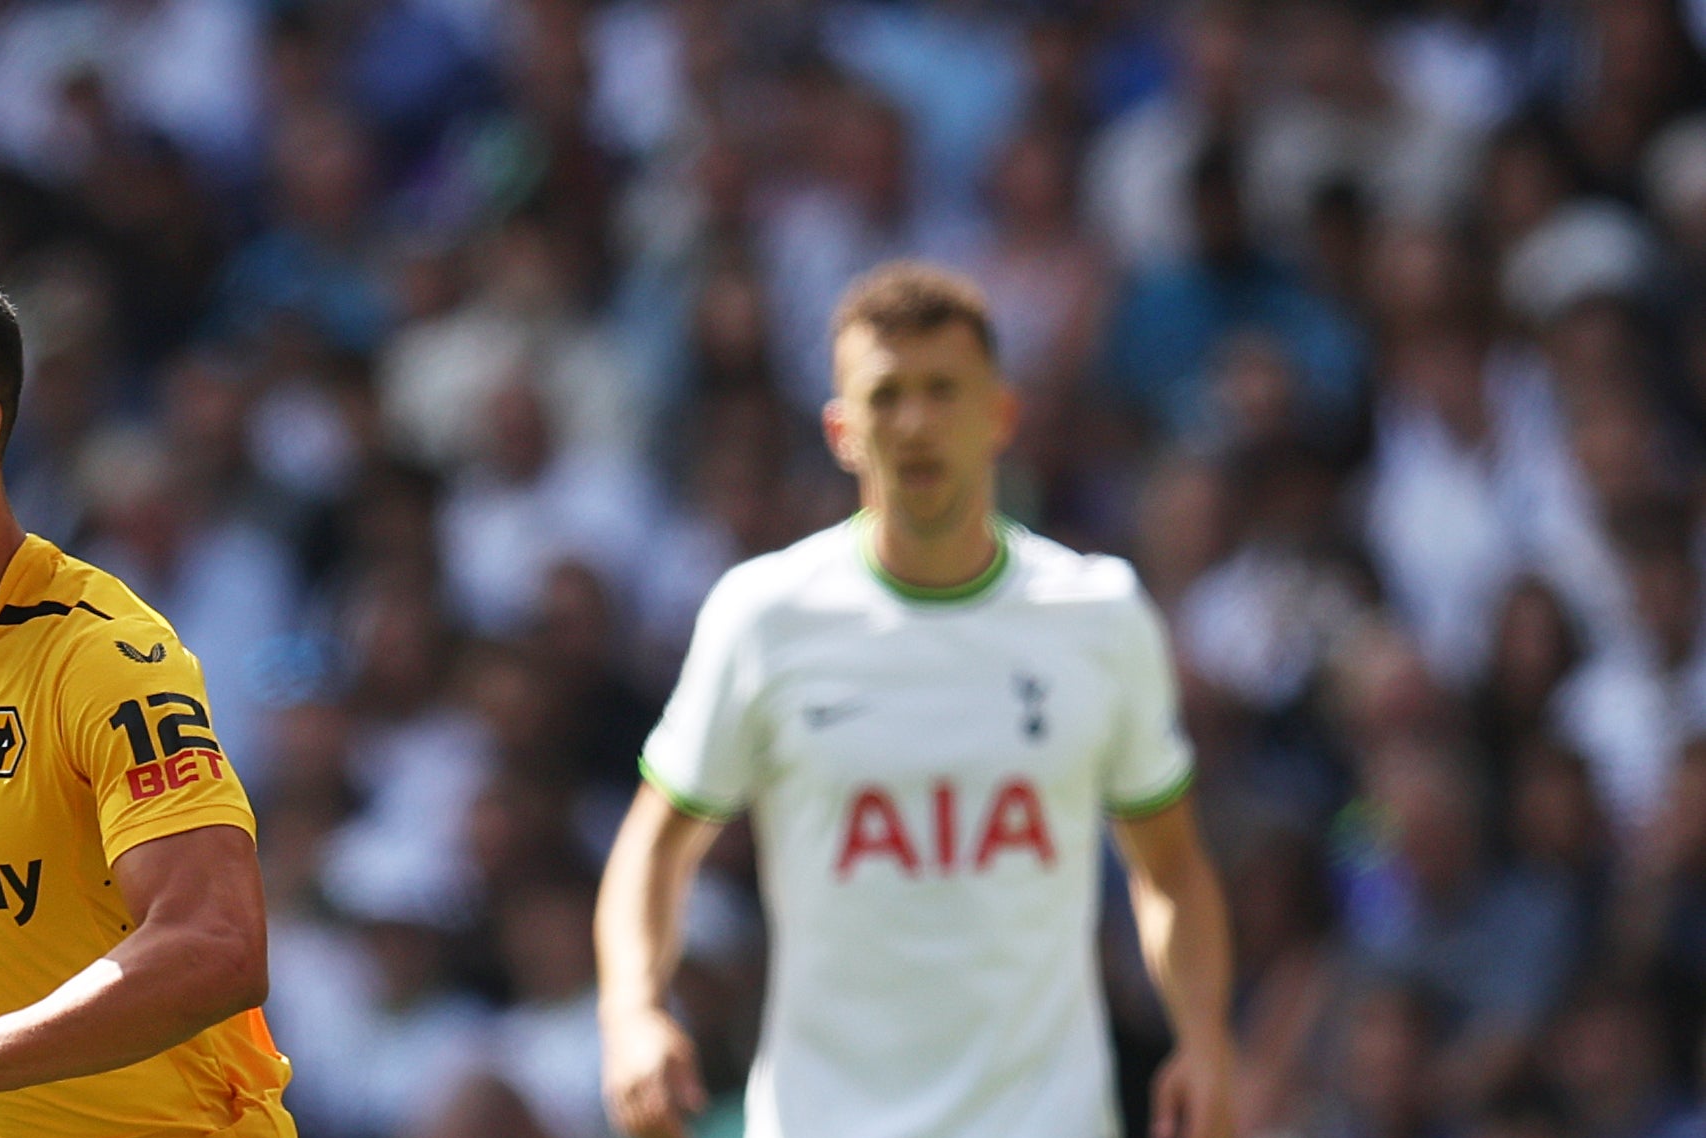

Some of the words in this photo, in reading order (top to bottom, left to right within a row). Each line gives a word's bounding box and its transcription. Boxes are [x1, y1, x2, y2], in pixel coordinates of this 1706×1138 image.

[109, 691, 221, 766] 12
[125, 749, 224, 801] BET
[834, 774, 1058, 880] AIA
